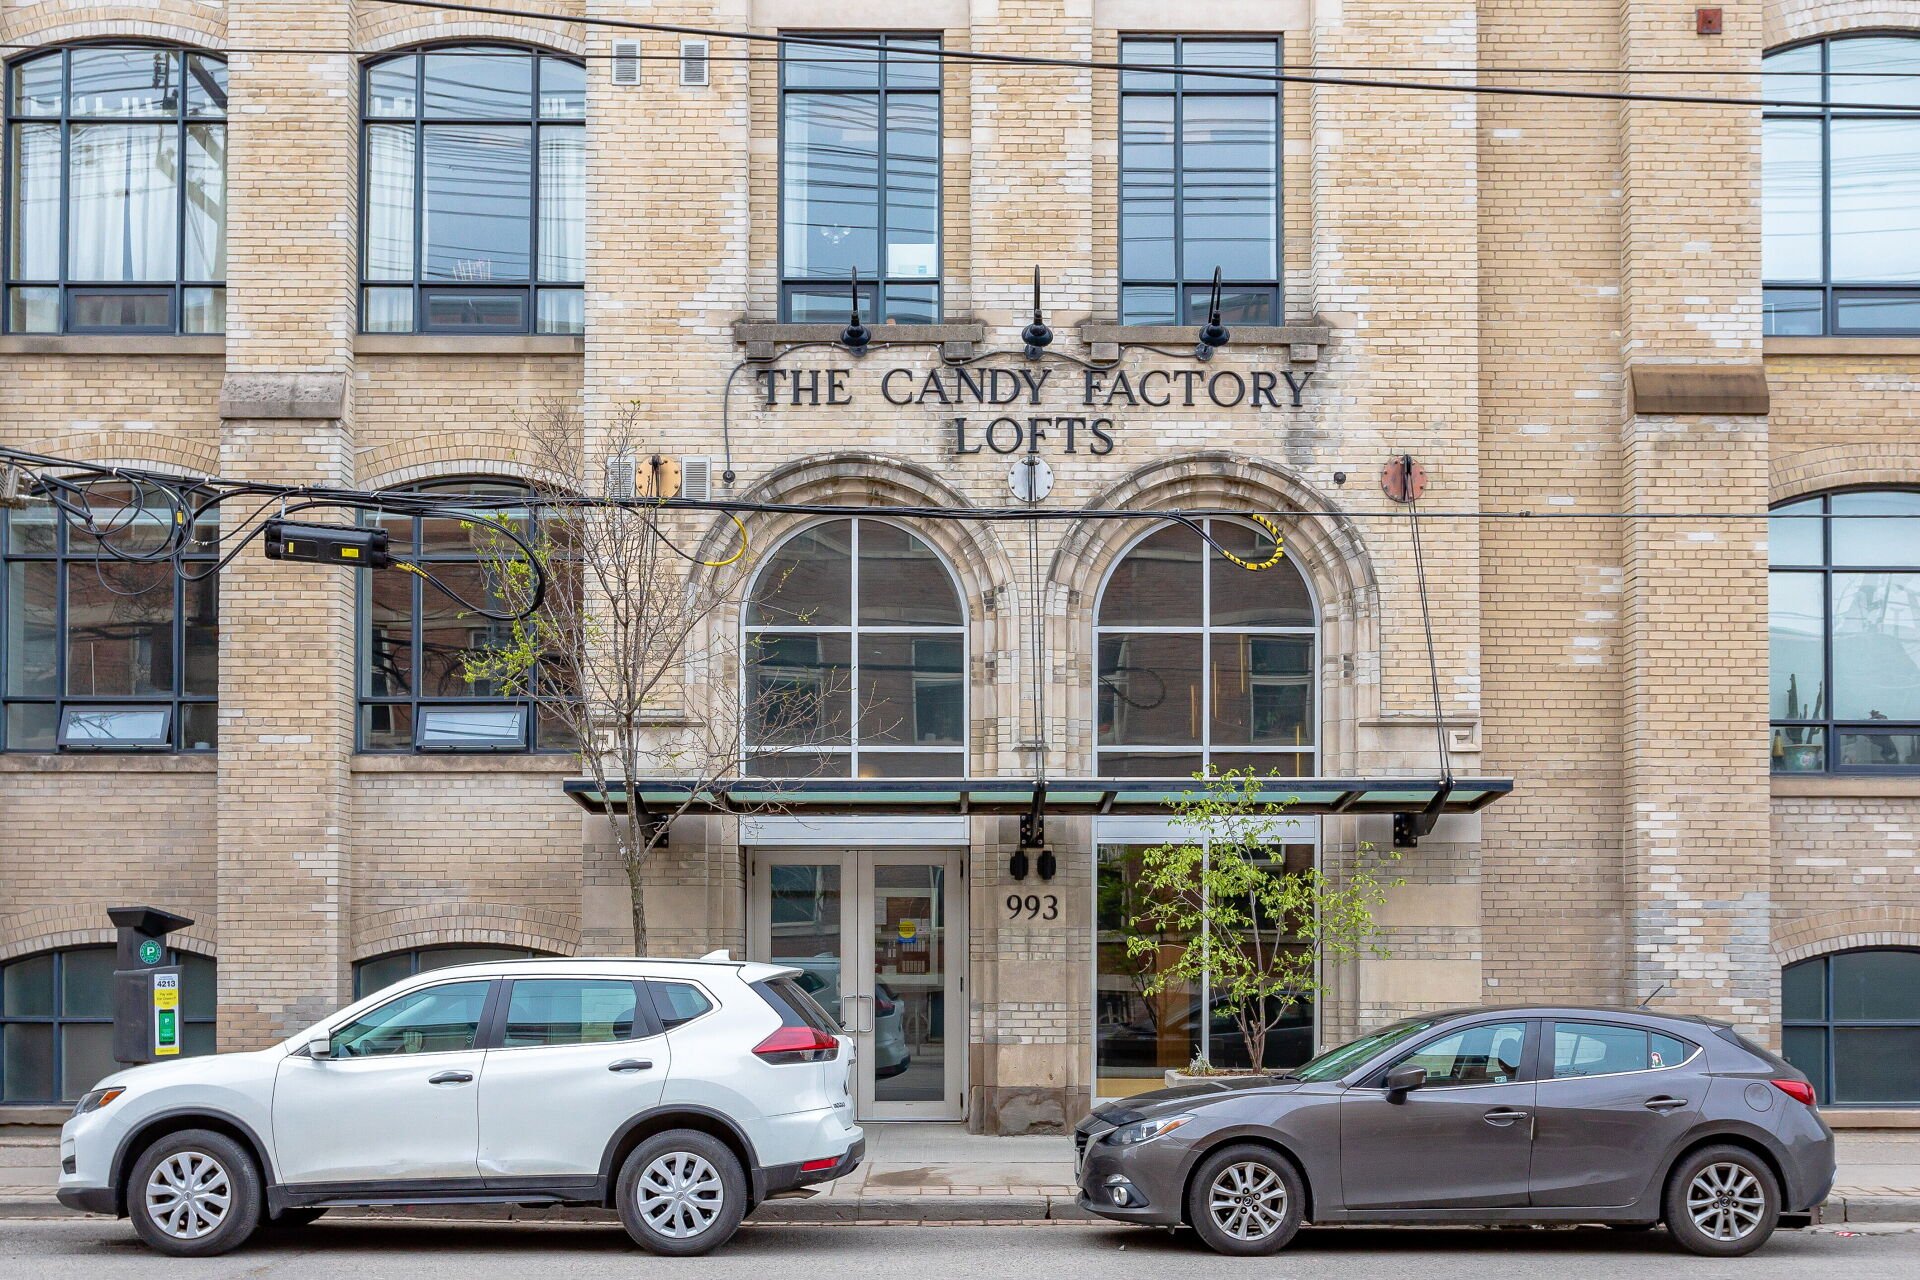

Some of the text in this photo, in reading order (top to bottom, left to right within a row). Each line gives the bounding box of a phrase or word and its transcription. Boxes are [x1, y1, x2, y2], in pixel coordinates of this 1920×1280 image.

[756, 367, 1314, 407] THE CANDY FACTORY
[955, 417, 1114, 455] LOFTS
[1006, 894, 1059, 920] 993
[146, 946, 155, 956] P
[157, 980, 176, 988] 4213
